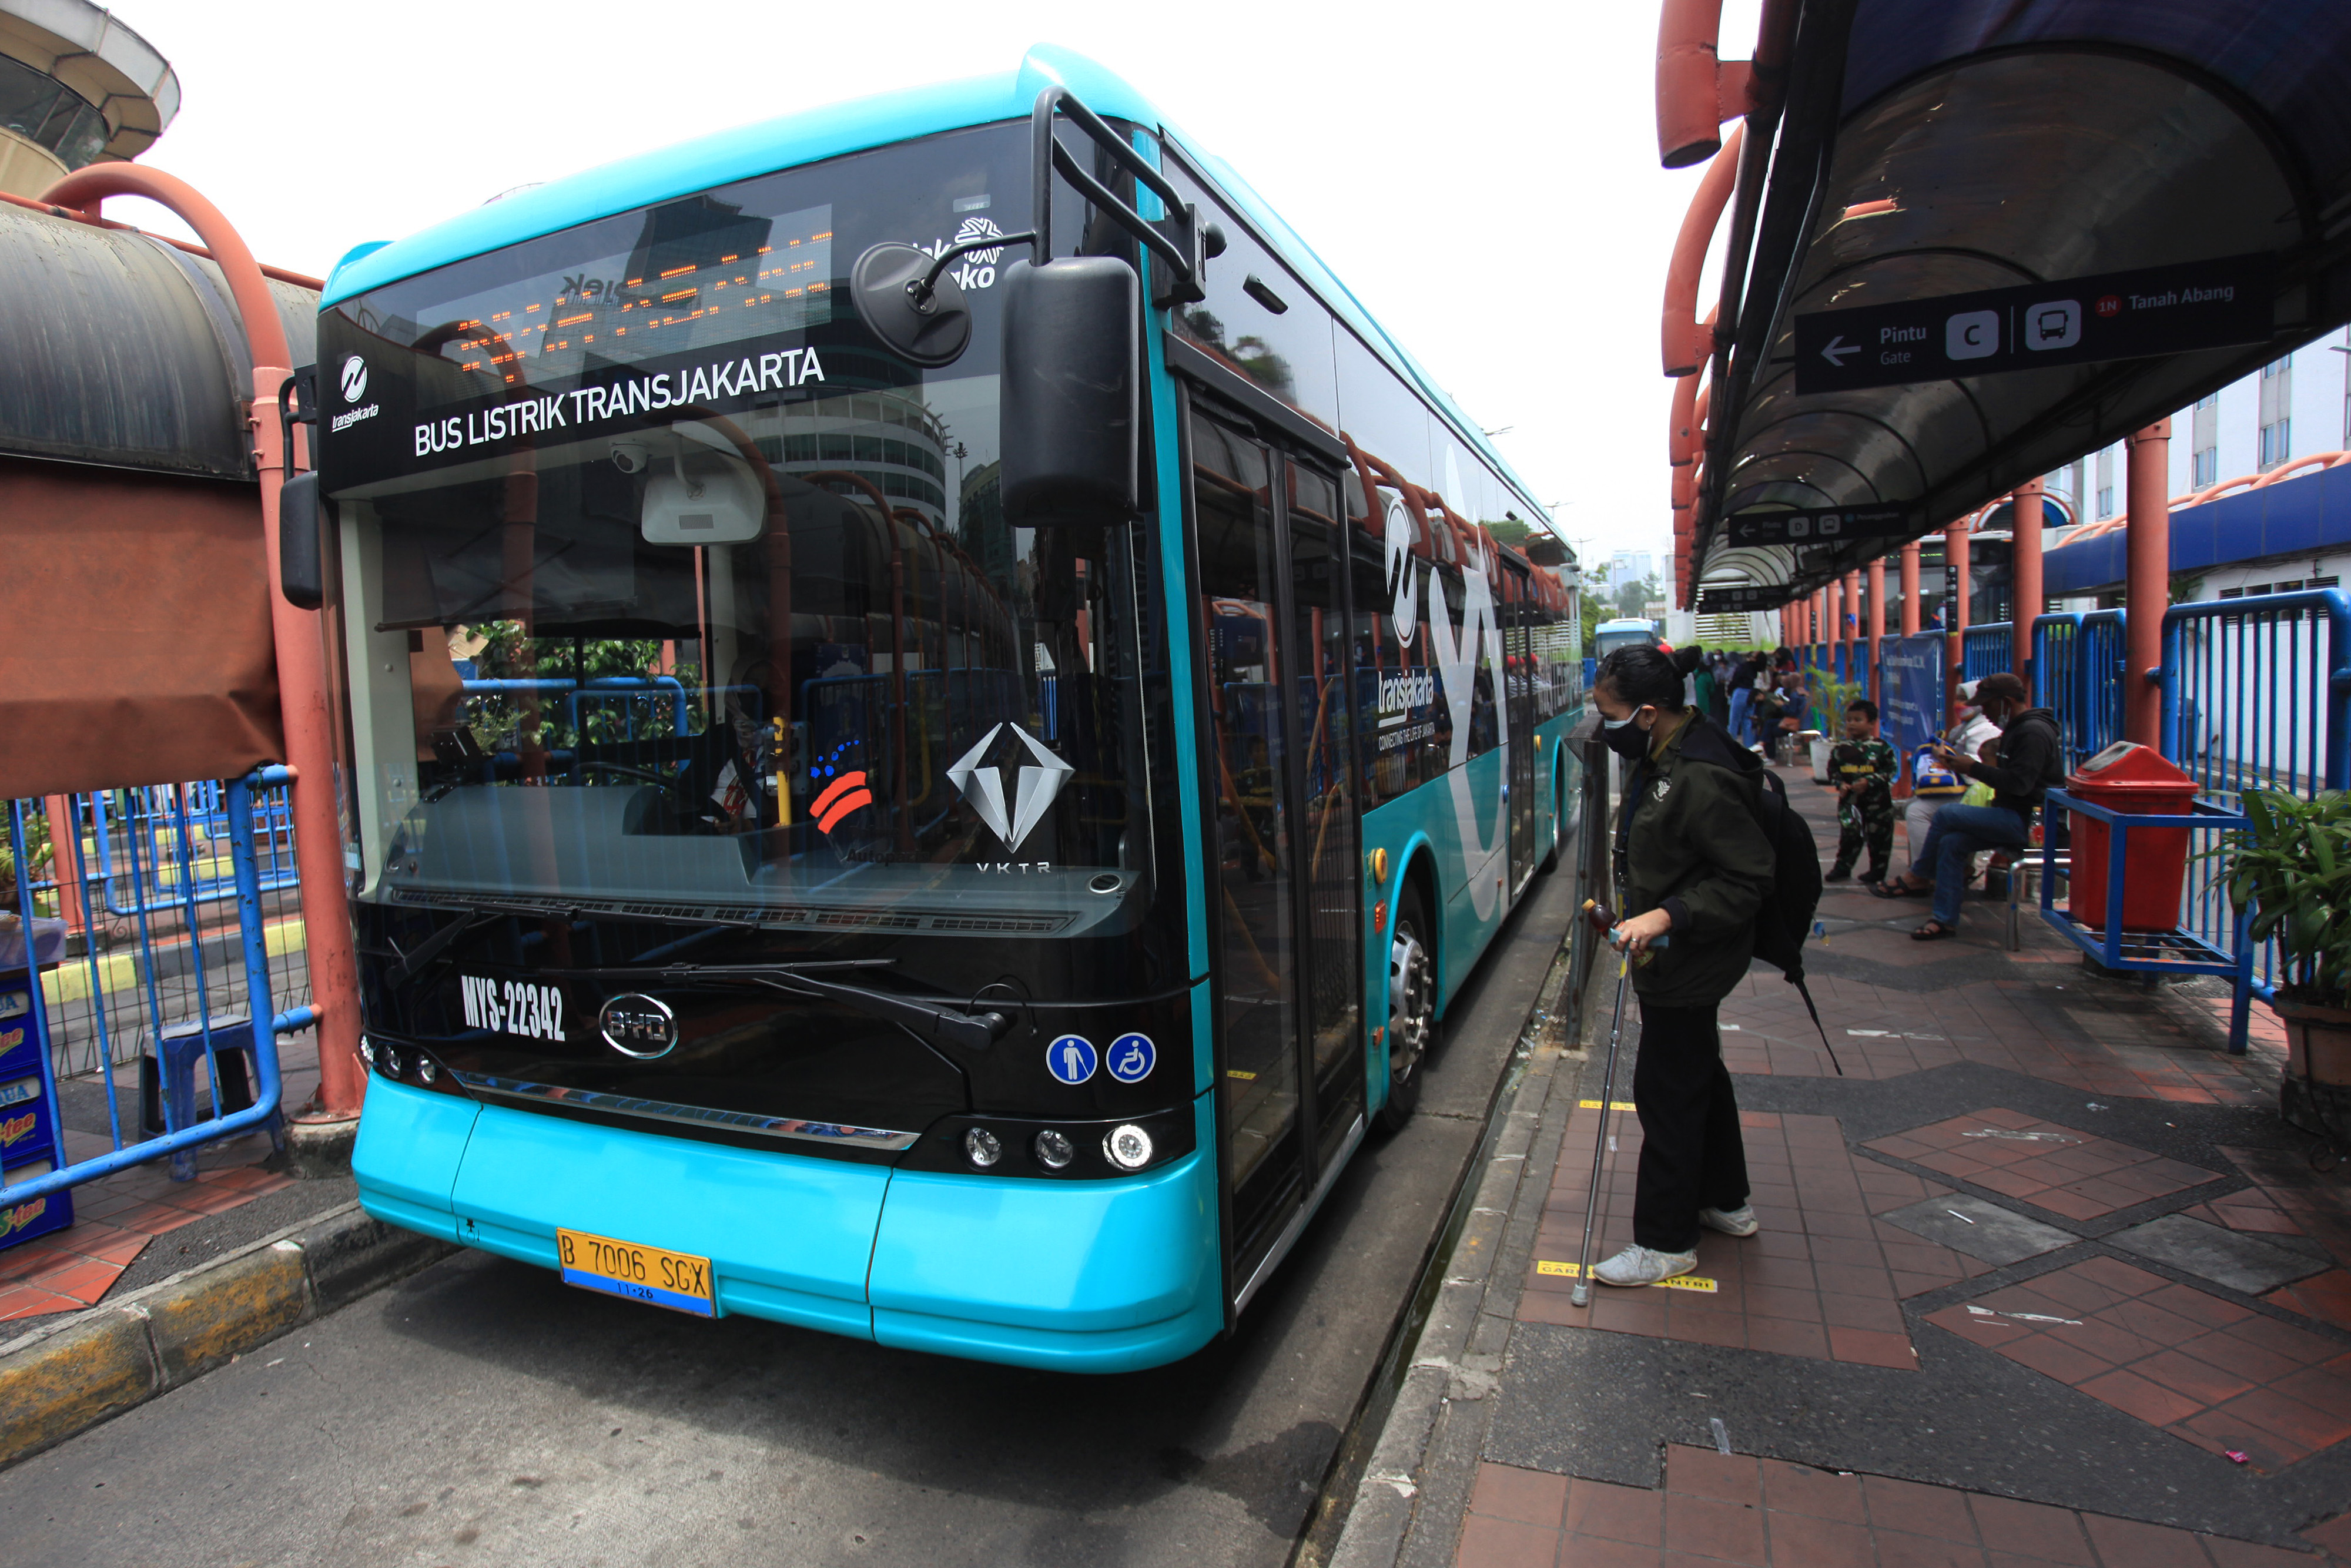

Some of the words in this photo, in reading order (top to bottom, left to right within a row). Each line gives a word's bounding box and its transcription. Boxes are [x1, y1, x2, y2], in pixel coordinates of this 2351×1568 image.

[2098, 300, 2117, 313] 1N
[2129, 291, 2176, 310] Tanah
[2181, 286, 2233, 303] Abang
[1881, 327, 1926, 344] Pintu
[1964, 325, 1980, 346] C
[1881, 351, 1911, 365] Gate
[415, 417, 463, 457] BUS
[469, 394, 567, 445] LISTRIK
[569, 347, 825, 424] TRANSJAKARTA
[332, 404, 379, 433] transjakarta
[1378, 669, 1434, 728] transjakarta
[1379, 730, 1404, 751] CONNECTING
[976, 862, 1051, 875] VKTR
[461, 975, 565, 1042] MYS-22342
[607, 1010, 667, 1041] BYD
[561, 1235, 575, 1264] B
[589, 1241, 645, 1280] 7006
[661, 1257, 706, 1296] SGX
